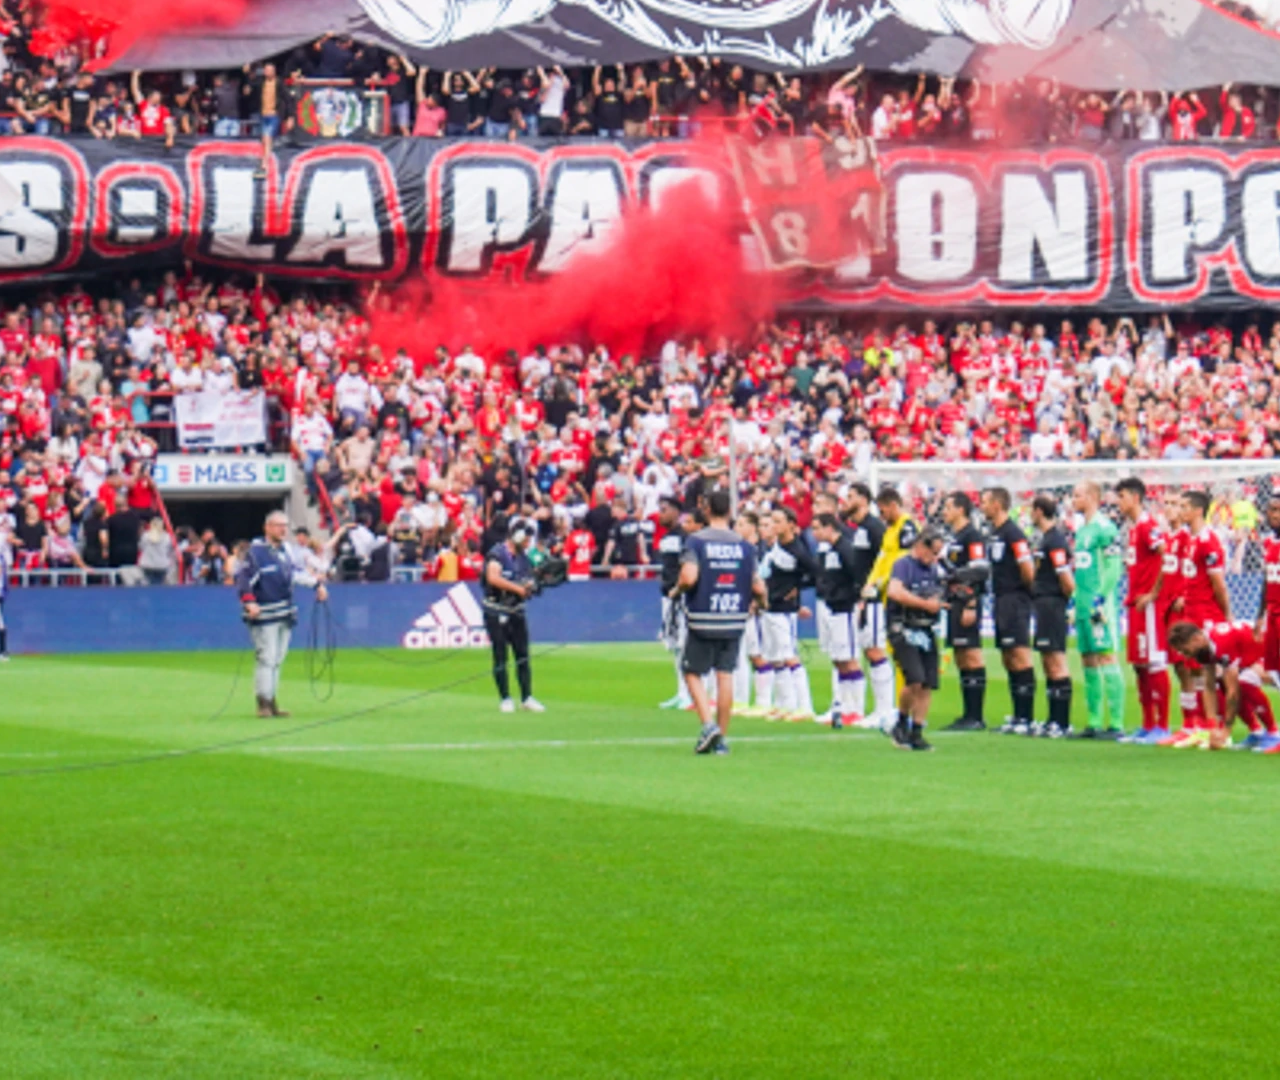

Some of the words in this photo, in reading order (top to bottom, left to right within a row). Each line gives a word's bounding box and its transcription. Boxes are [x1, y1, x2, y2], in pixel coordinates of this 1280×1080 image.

[209, 166, 385, 265] LA
[447, 166, 1091, 283] PAON
[195, 463, 257, 482] MAES
[404, 626, 491, 649] adida
